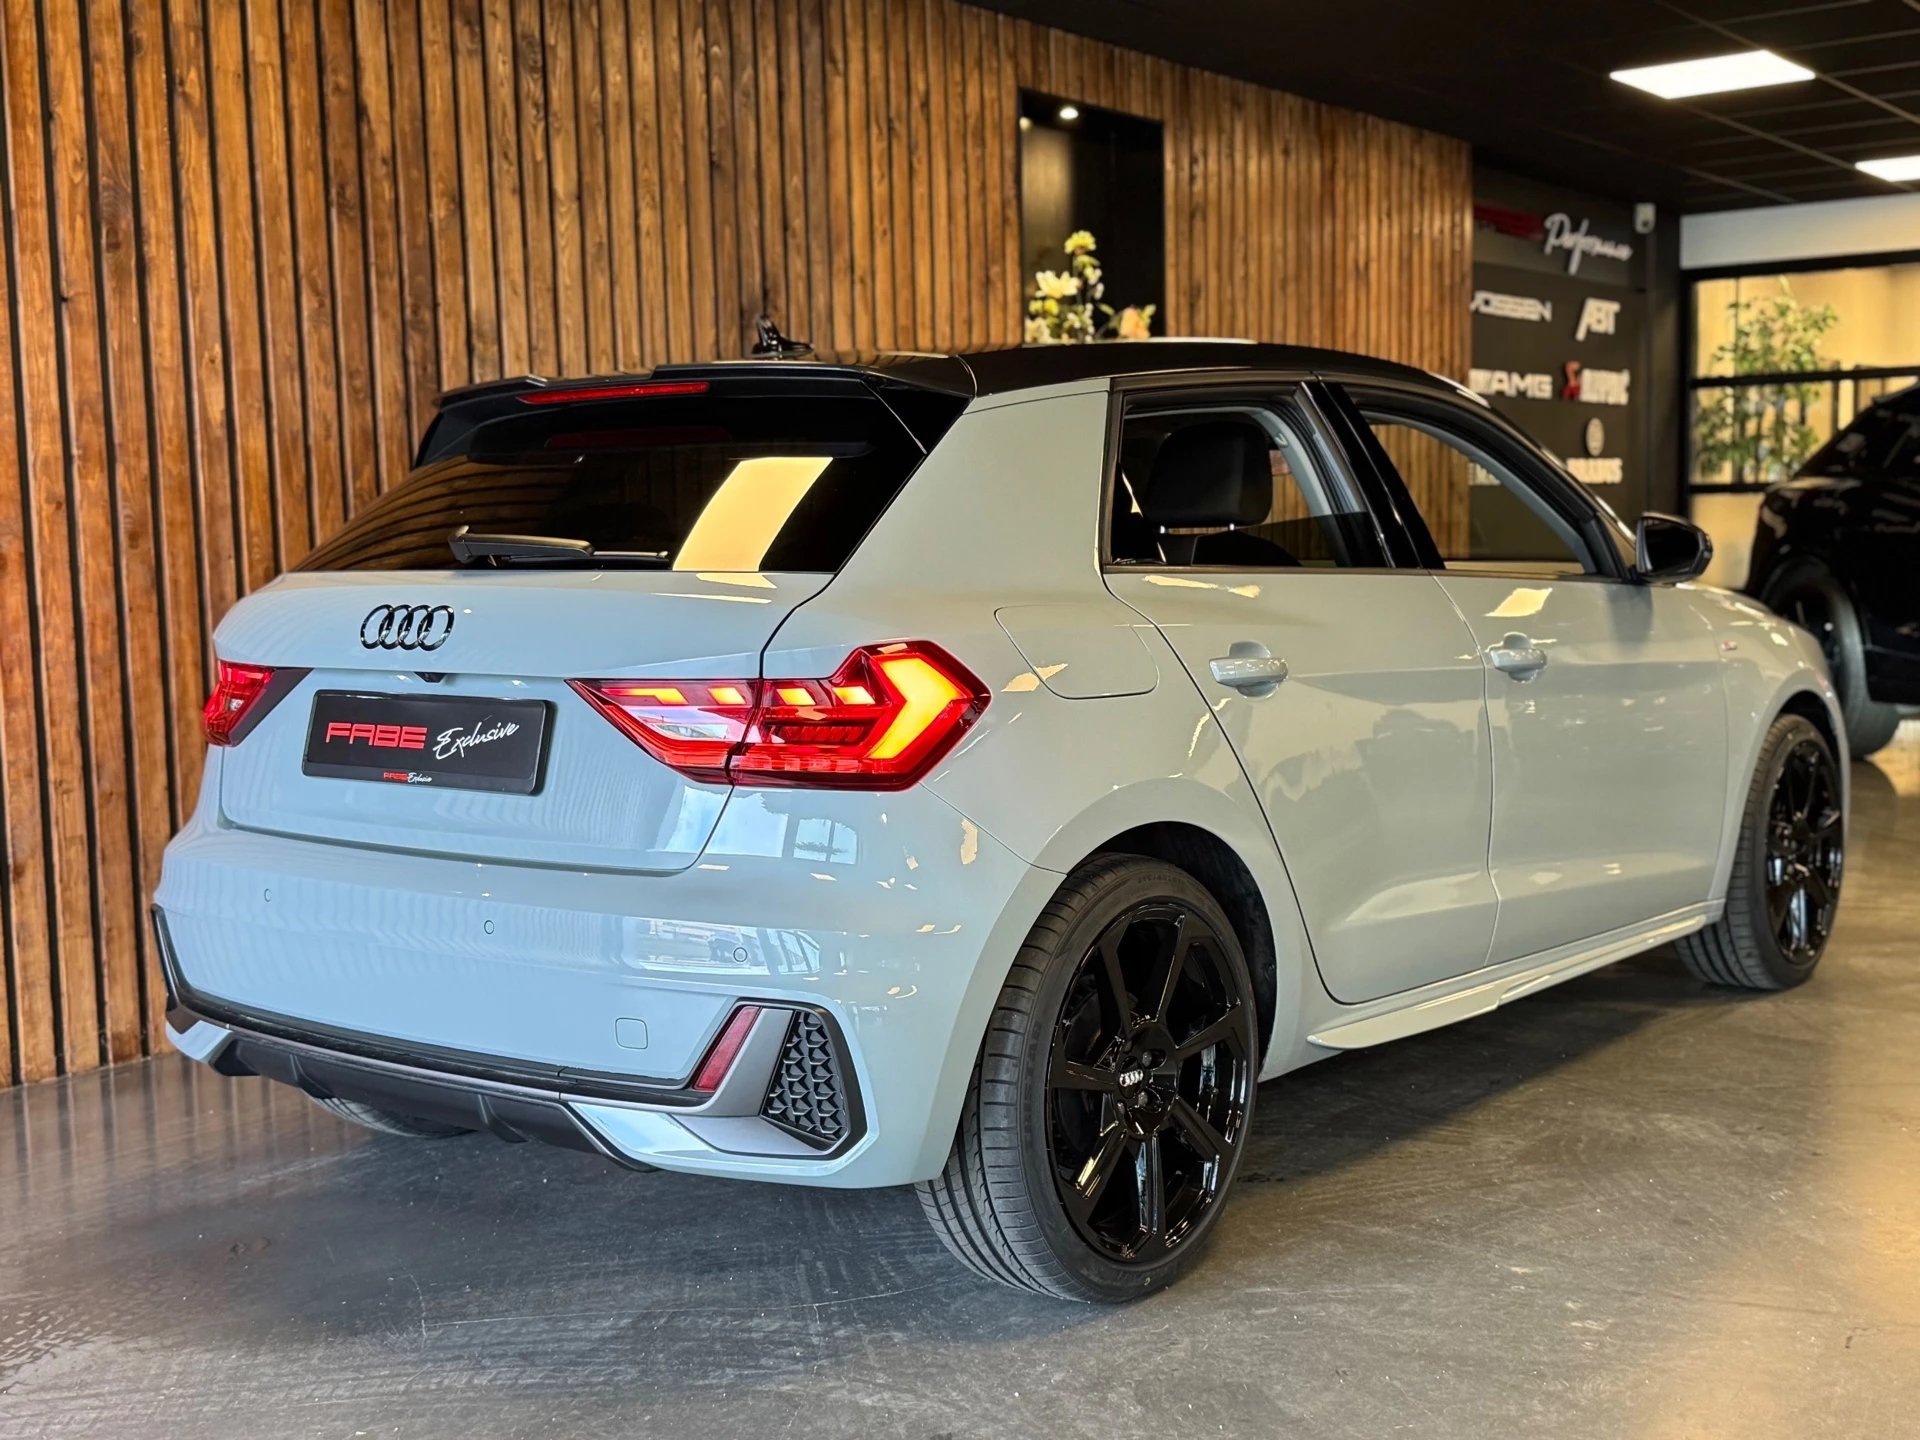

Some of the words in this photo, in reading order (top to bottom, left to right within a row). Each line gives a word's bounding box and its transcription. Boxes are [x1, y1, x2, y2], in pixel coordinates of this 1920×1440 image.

[1489, 370, 1553, 400] AMG
[326, 722, 428, 749] FABE
[432, 715, 520, 760] Exclusive
